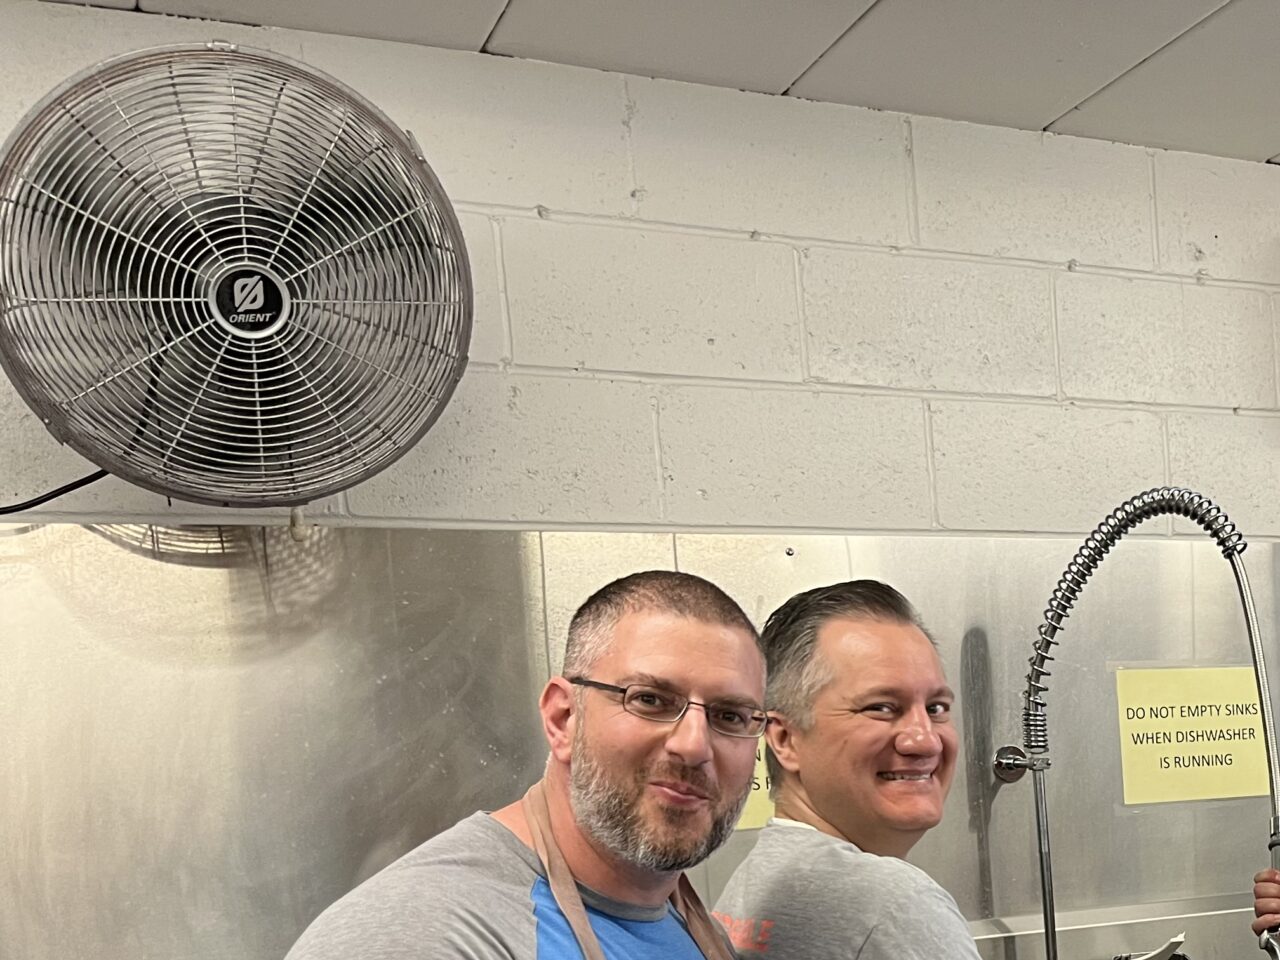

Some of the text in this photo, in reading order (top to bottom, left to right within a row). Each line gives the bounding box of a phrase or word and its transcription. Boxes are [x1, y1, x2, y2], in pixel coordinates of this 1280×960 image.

[229, 313, 272, 323] ORIENT
[1126, 703, 1258, 720] DO NOT EMPTY SINKS
[1131, 727, 1256, 745] WHEN DISHWASHER
[1160, 753, 1233, 769] IS RUNNING
